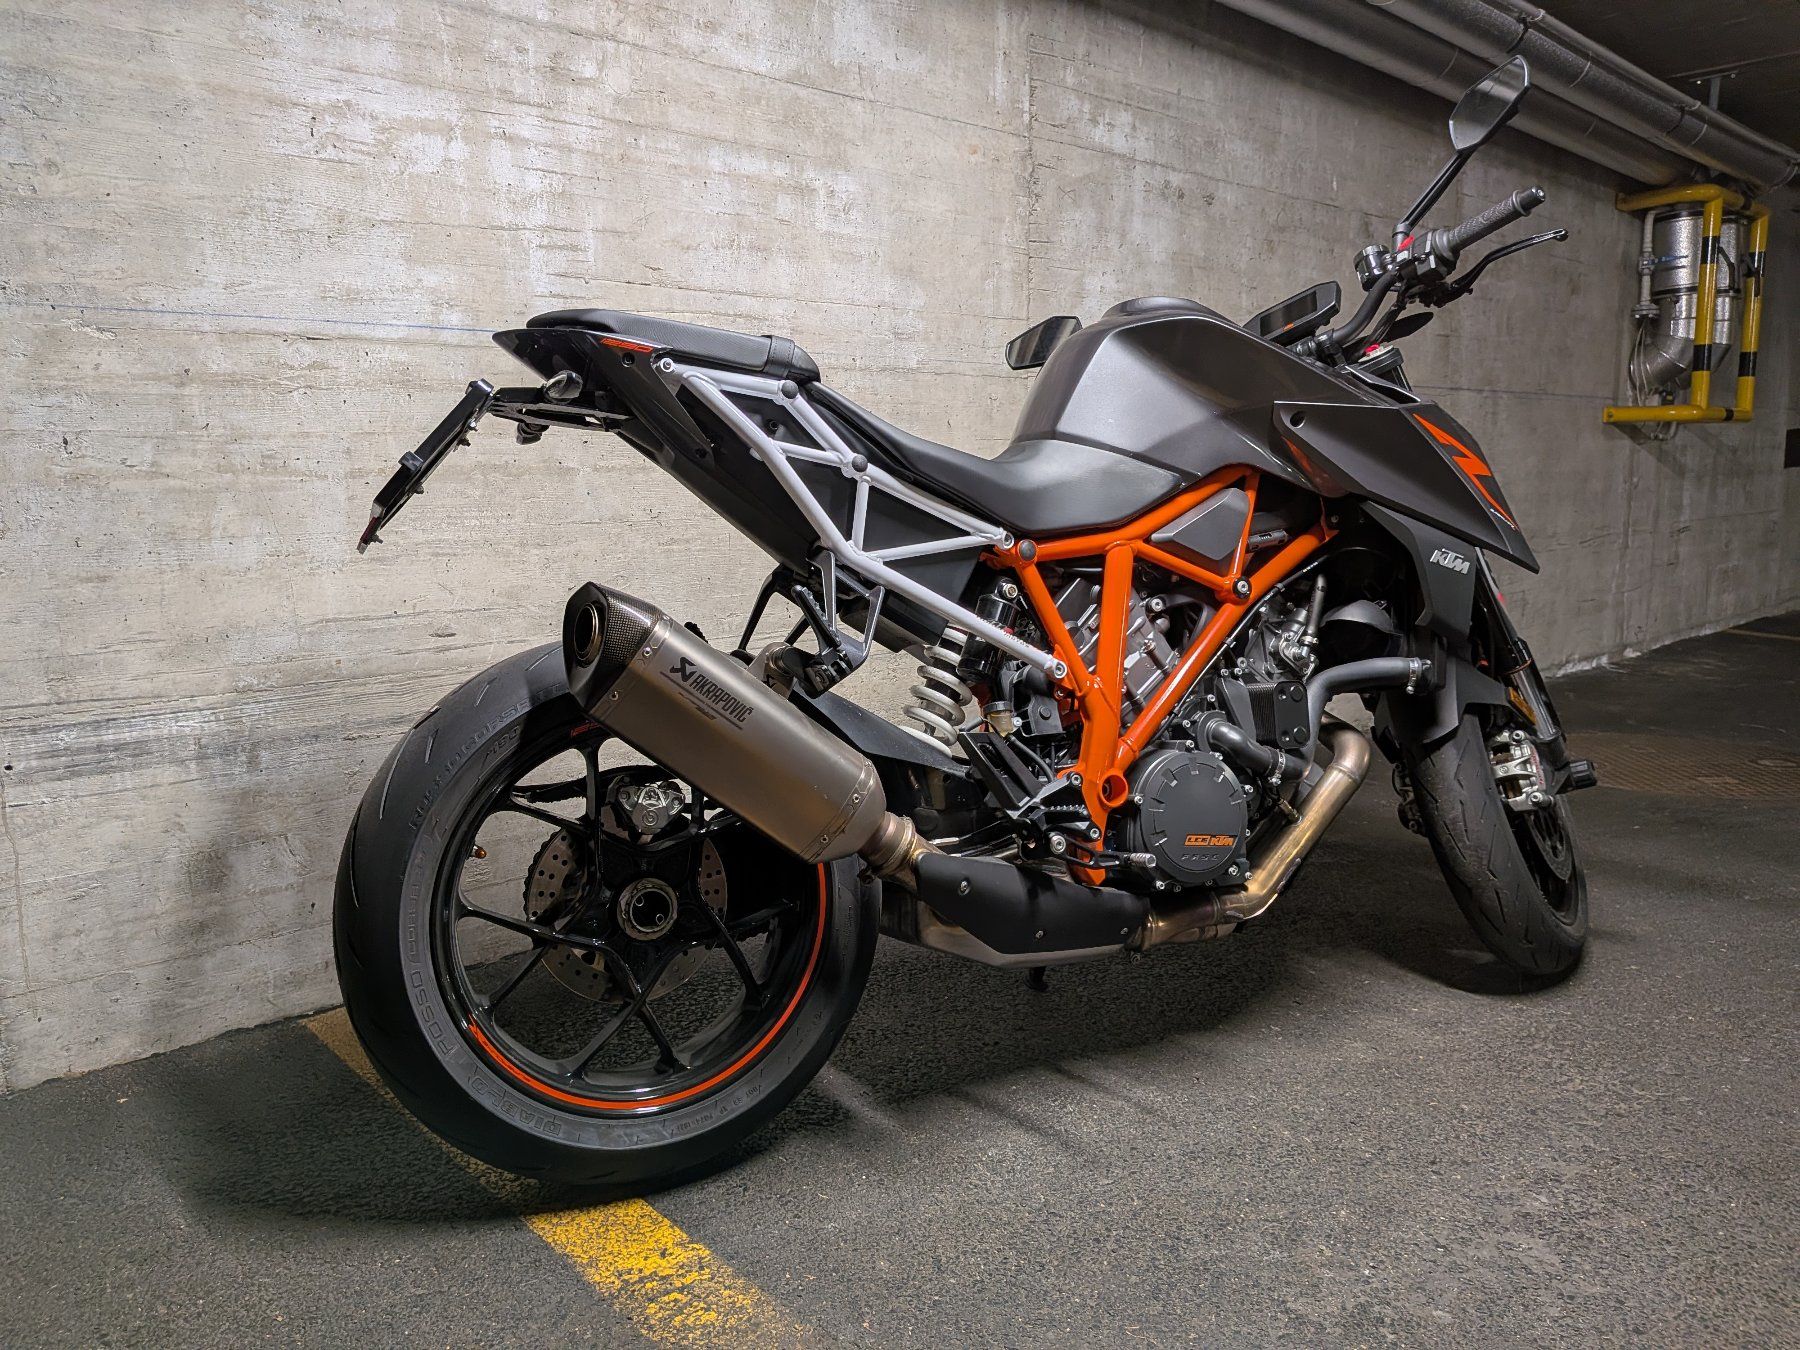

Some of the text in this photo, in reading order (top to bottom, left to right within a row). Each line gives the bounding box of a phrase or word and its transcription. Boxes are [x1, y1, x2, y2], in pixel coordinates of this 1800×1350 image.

[1430, 548, 1471, 574] KTM
[1210, 835, 1233, 846] KTM
[410, 969, 456, 1056] ROSSO
[468, 1075, 562, 1137] DIABLO
